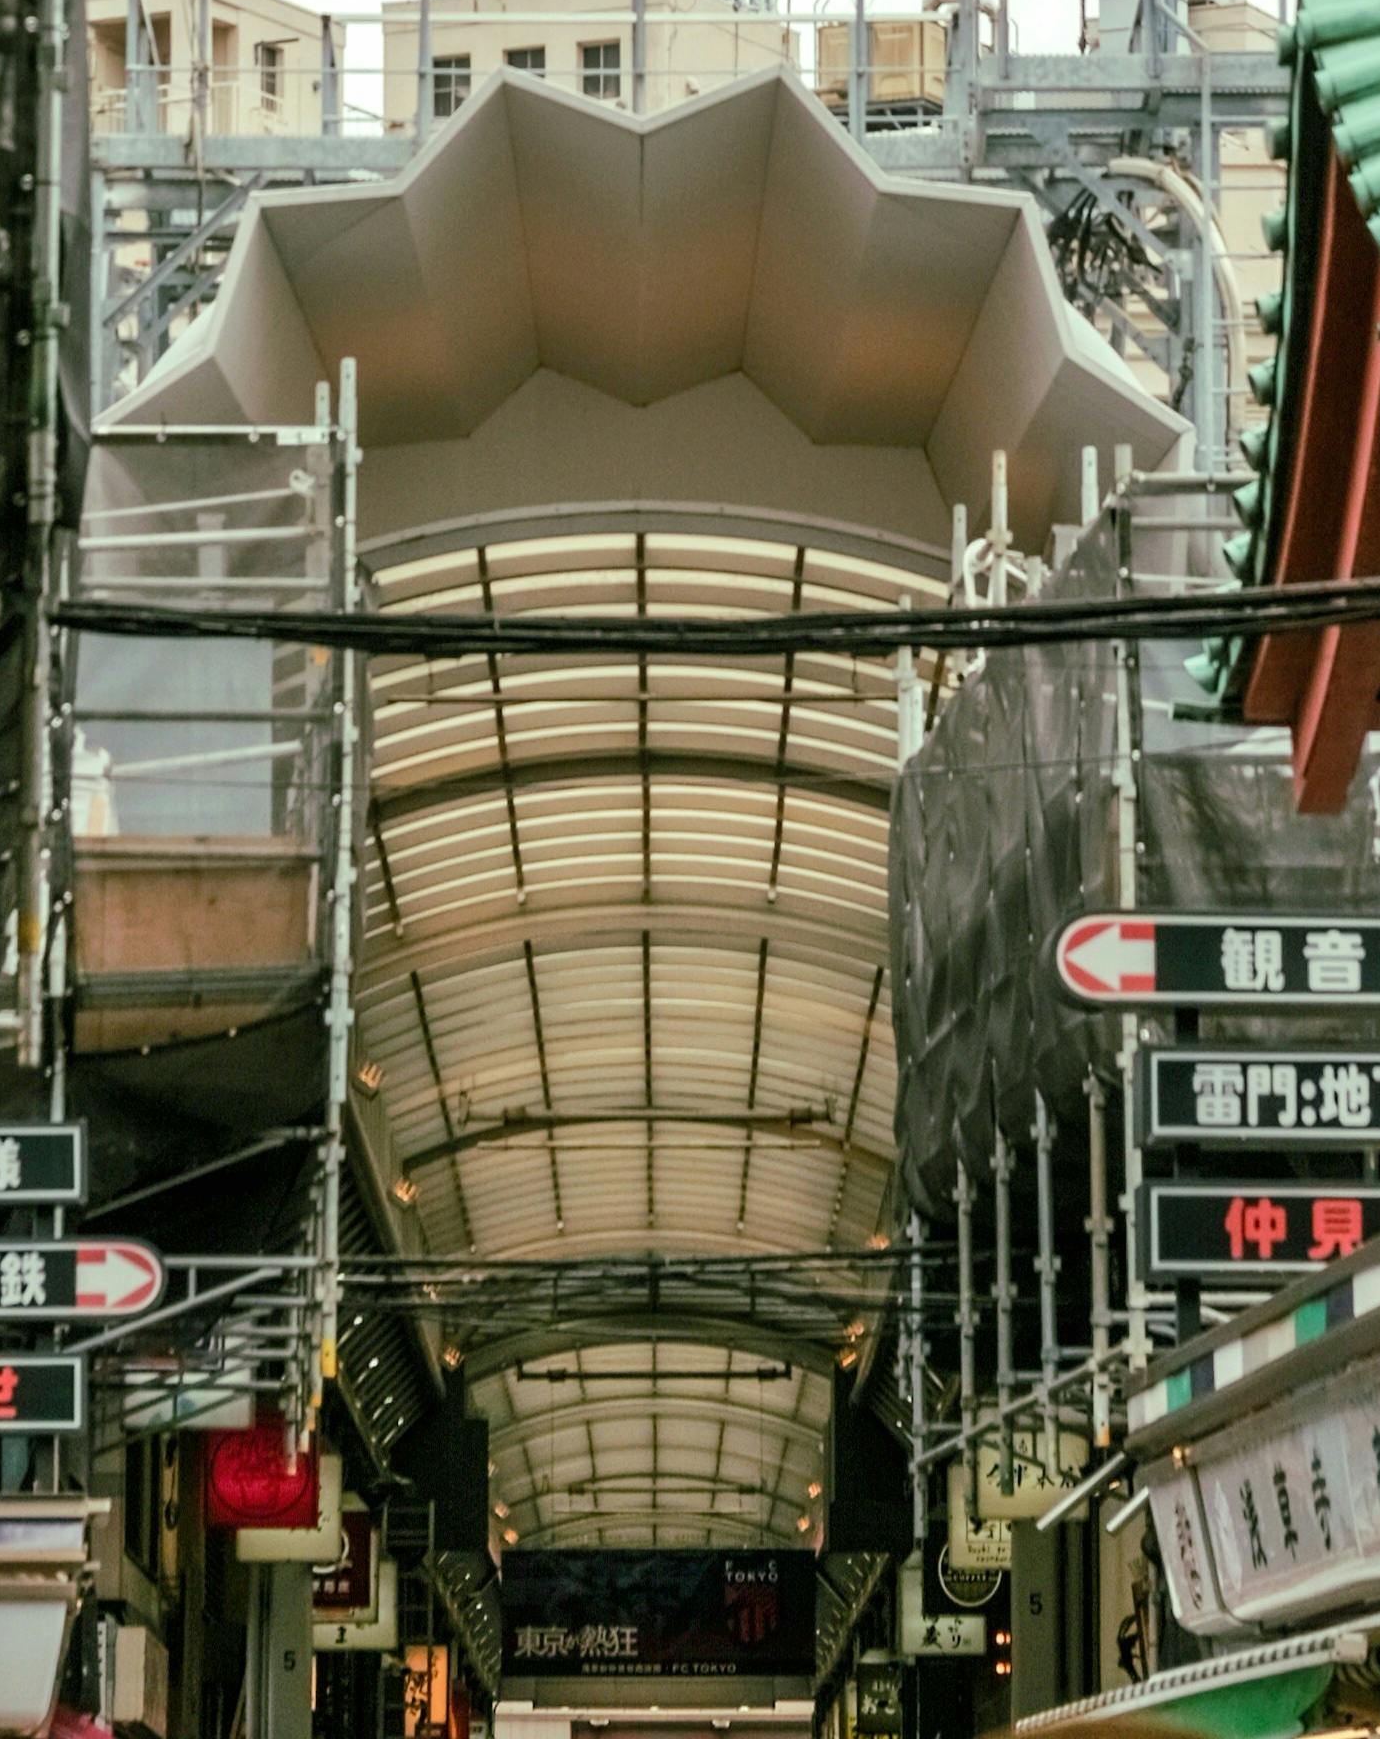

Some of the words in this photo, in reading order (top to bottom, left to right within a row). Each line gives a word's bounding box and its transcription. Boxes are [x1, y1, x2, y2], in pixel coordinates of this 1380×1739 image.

[725, 1572, 778, 1582] TOKYO
[1030, 1593, 1042, 1615] 5
[284, 1650, 295, 1670] 5
[693, 1663, 736, 1673] TOKYO
